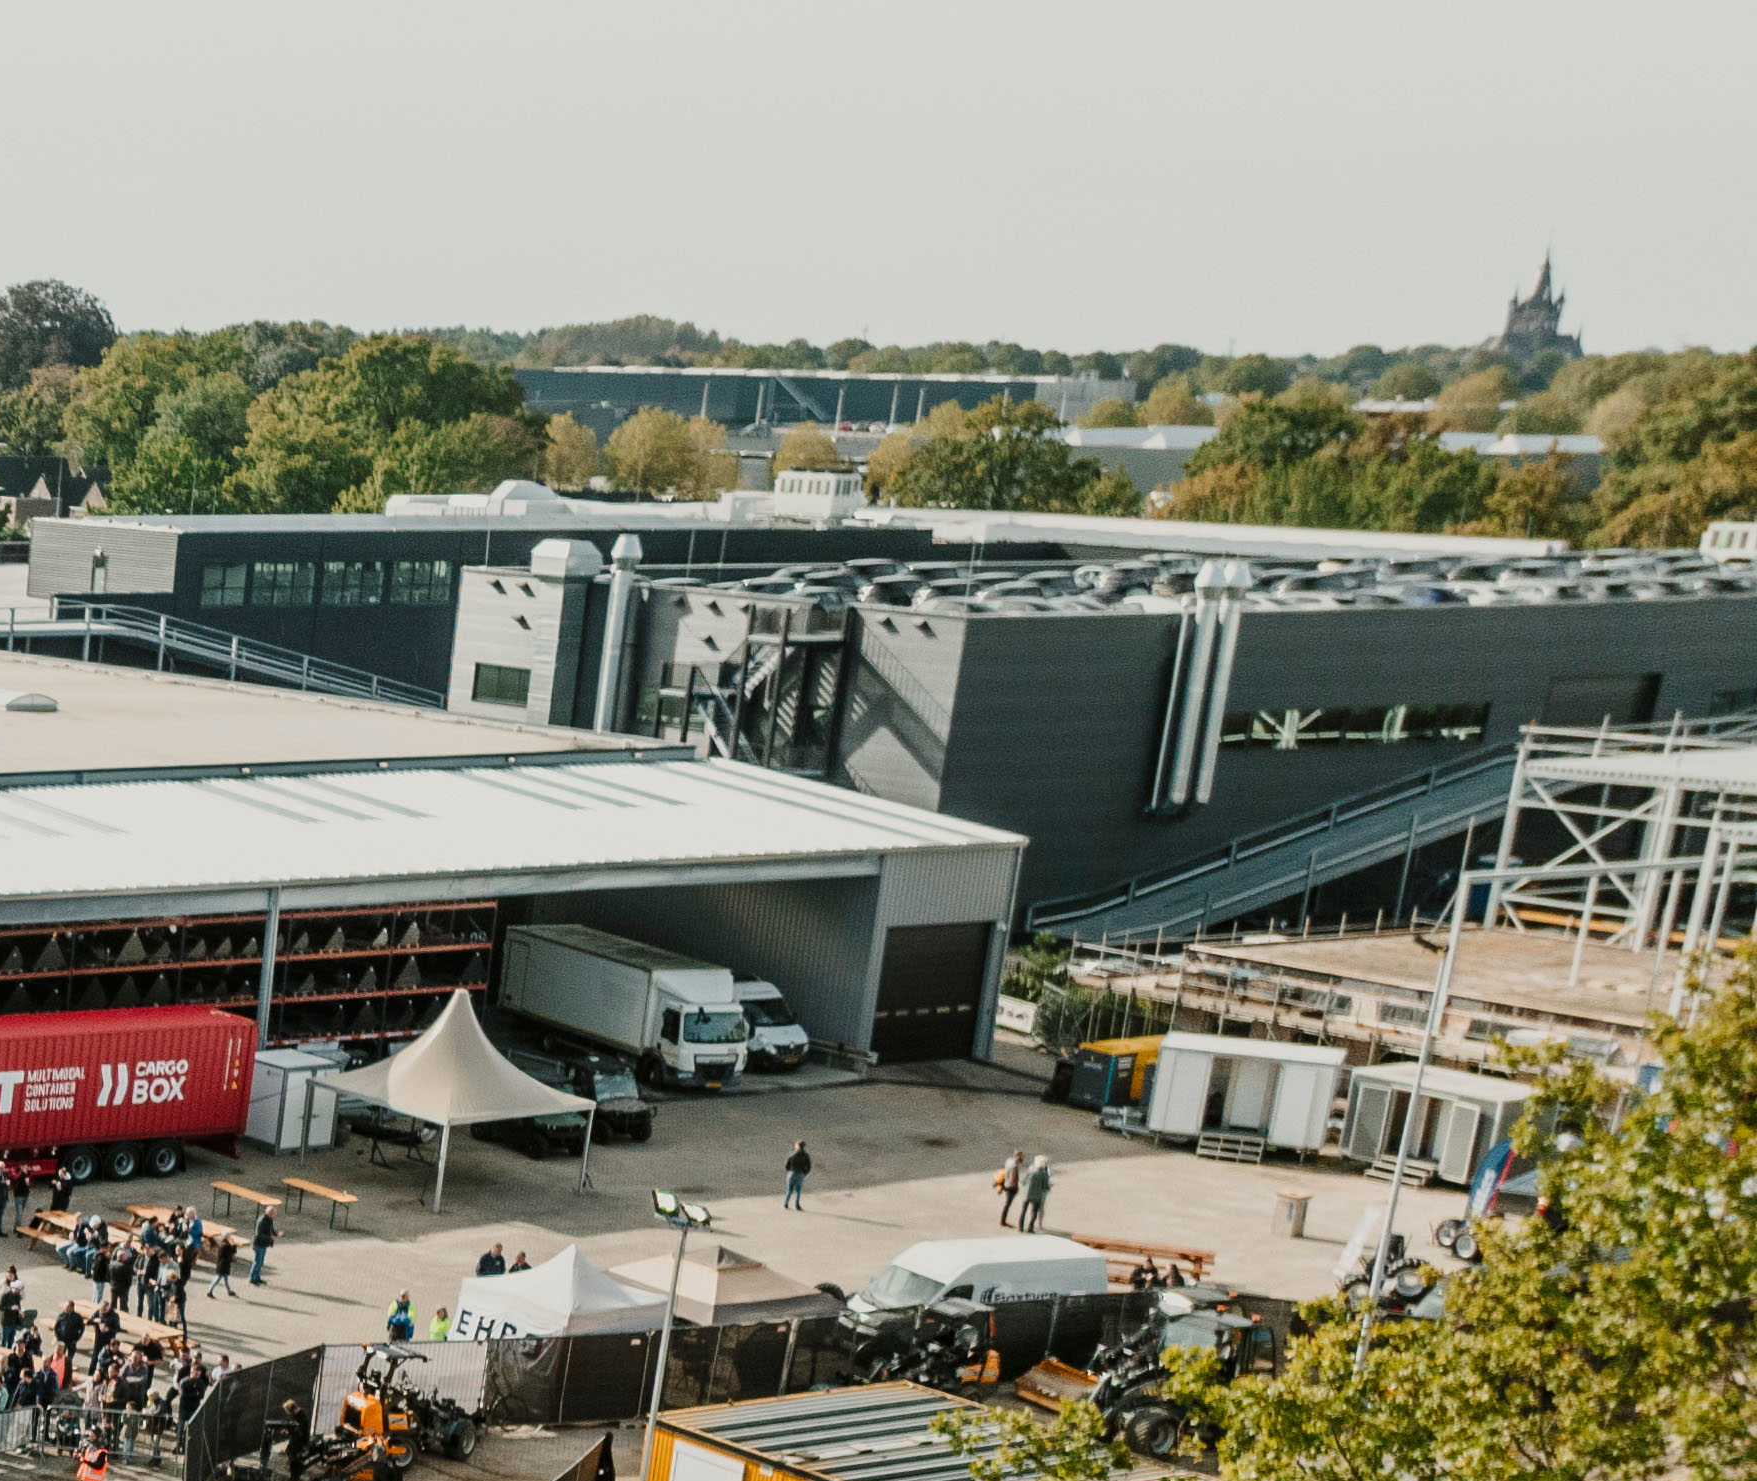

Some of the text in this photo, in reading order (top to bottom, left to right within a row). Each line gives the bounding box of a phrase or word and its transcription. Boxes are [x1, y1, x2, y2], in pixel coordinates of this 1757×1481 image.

[27, 1066, 85, 1083] MULTIMODAL
[135, 1059, 189, 1077] CARGO
[26, 1082, 76, 1098] CONTAINER
[131, 1077, 187, 1105] BOX
[24, 1098, 74, 1112] SOLUTIONS
